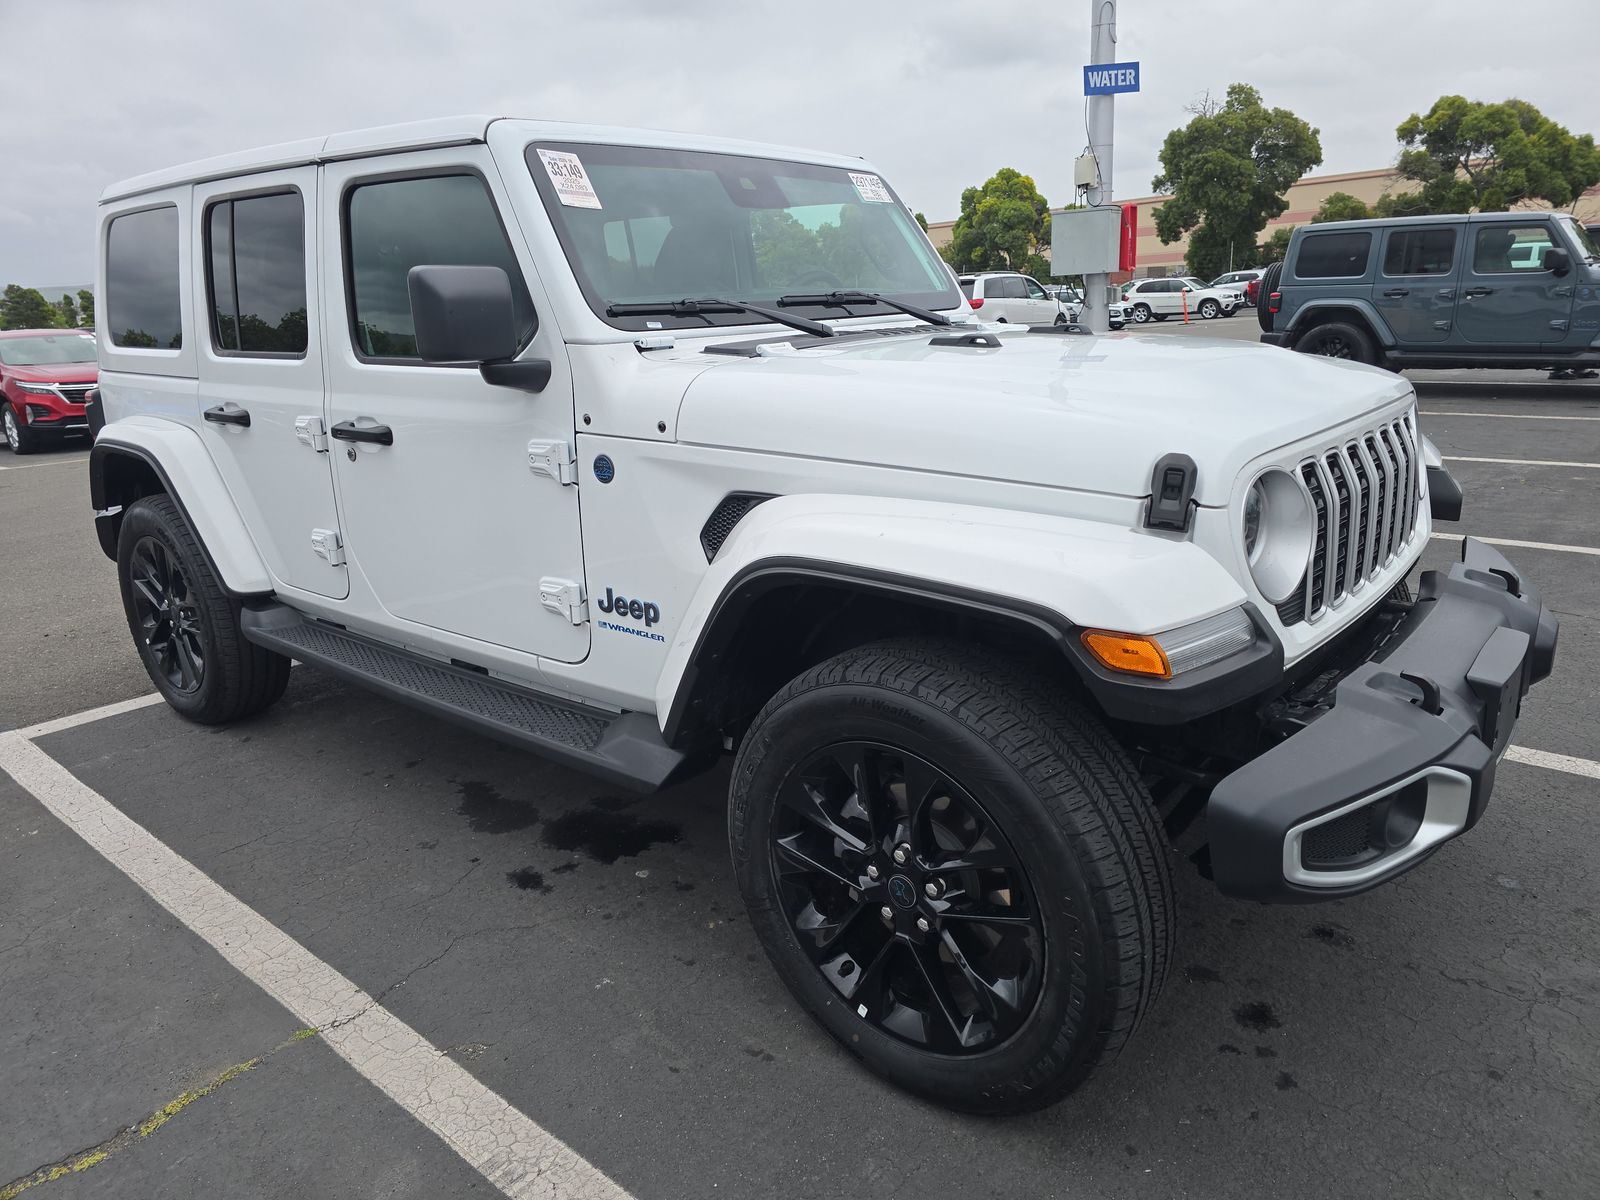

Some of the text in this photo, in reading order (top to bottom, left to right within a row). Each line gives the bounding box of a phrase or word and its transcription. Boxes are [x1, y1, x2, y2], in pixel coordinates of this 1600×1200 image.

[1088, 69, 1136, 88] WATER
[548, 161, 583, 179] 33:149
[598, 587, 660, 628] Jeep
[607, 622, 665, 643] WRANGLER
[851, 696, 927, 725] All-Weather
